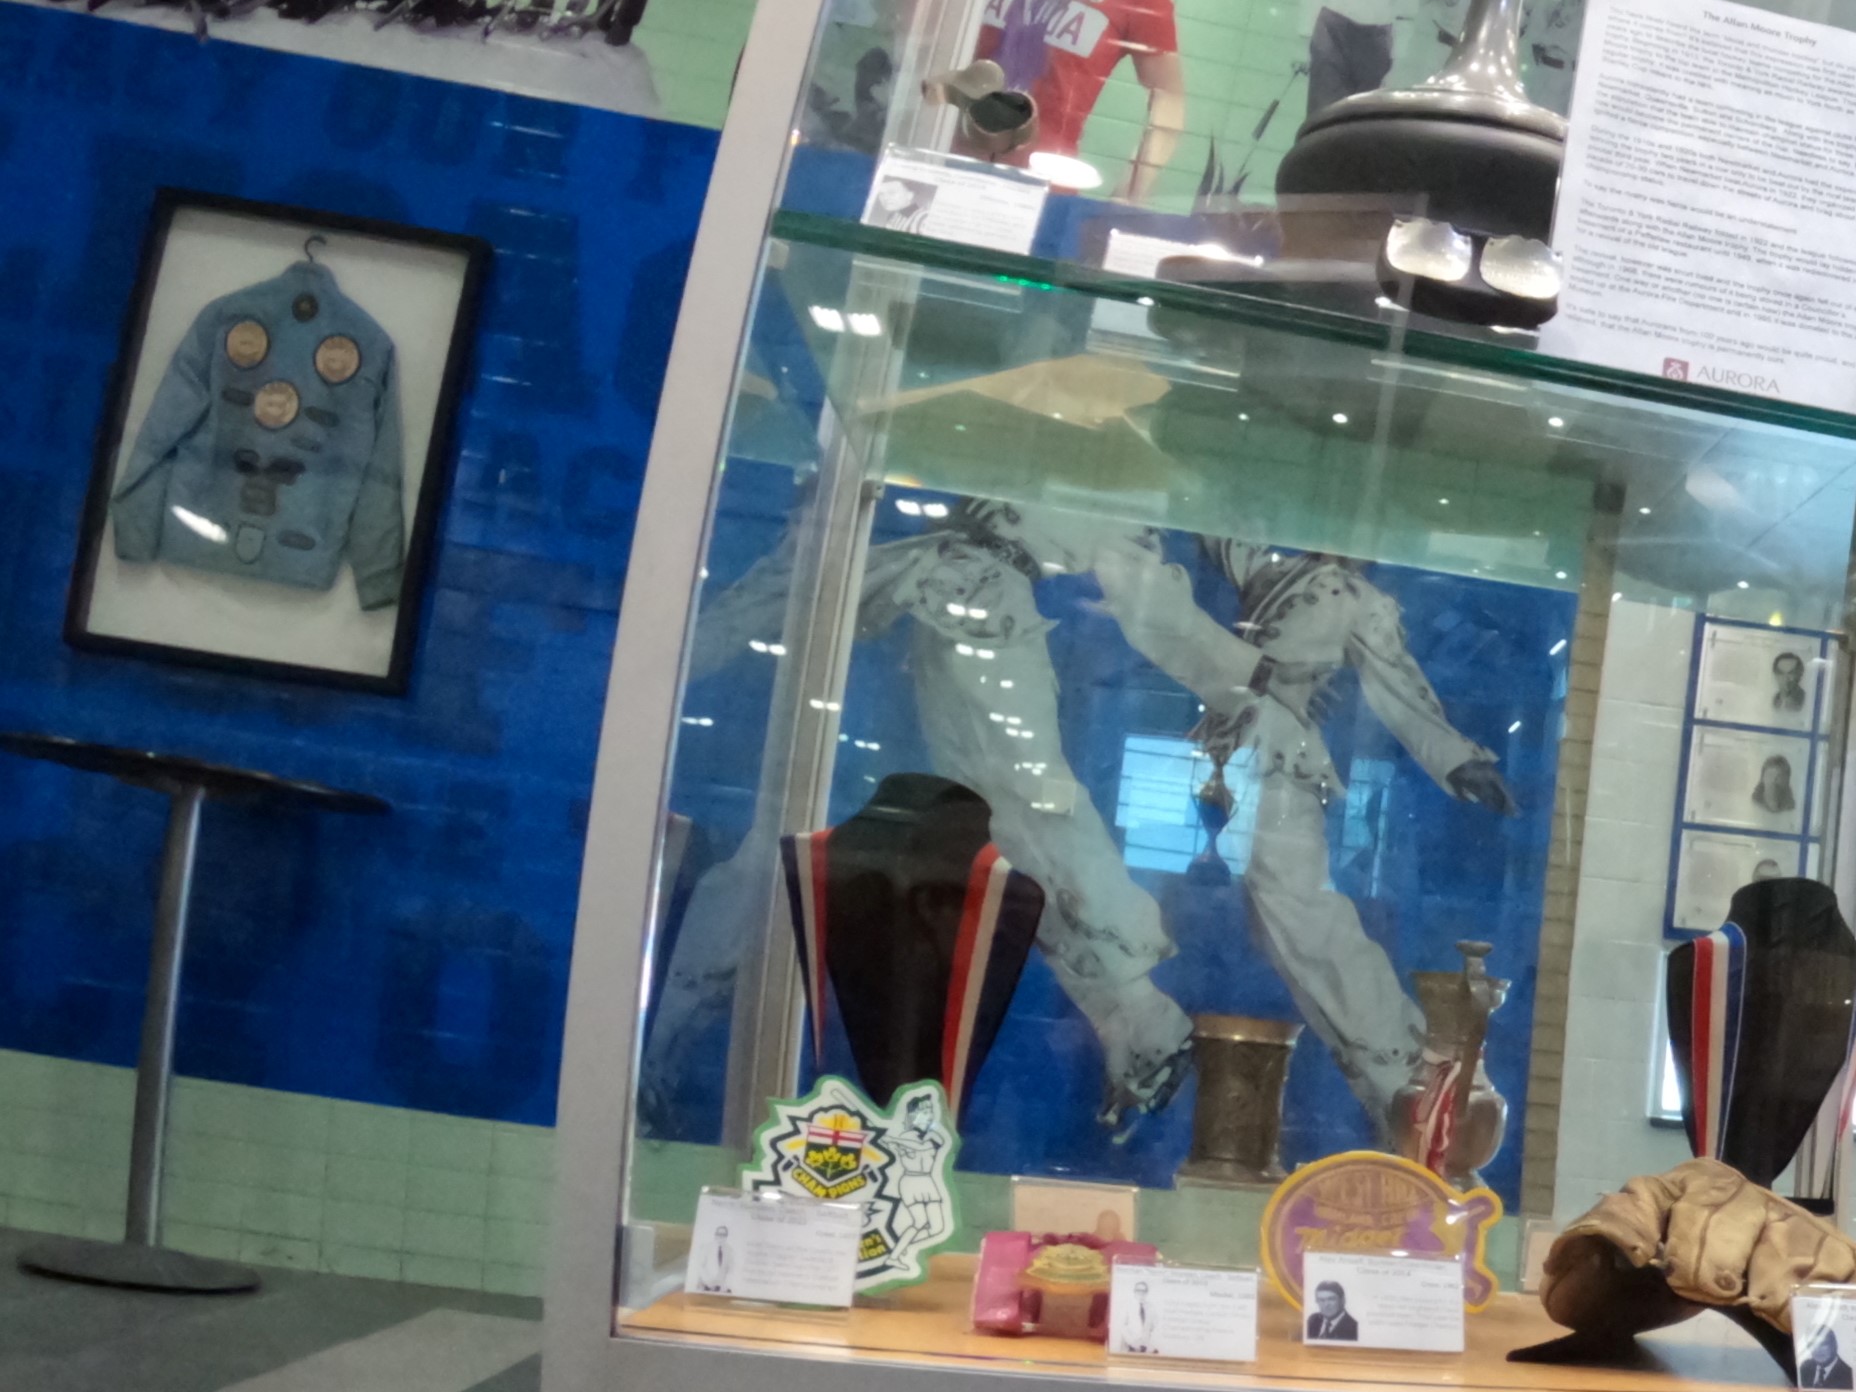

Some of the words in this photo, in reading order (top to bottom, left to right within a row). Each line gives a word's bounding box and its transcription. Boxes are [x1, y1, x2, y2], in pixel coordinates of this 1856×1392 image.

[1703, 10, 1721, 23] The
[1723, 16, 1749, 29] Allan
[1750, 22, 1781, 37] Moore
[1784, 31, 1818, 47] Trophy
[1696, 365, 1781, 394] AURORA
[791, 1167, 868, 1200] CHAMPIONS
